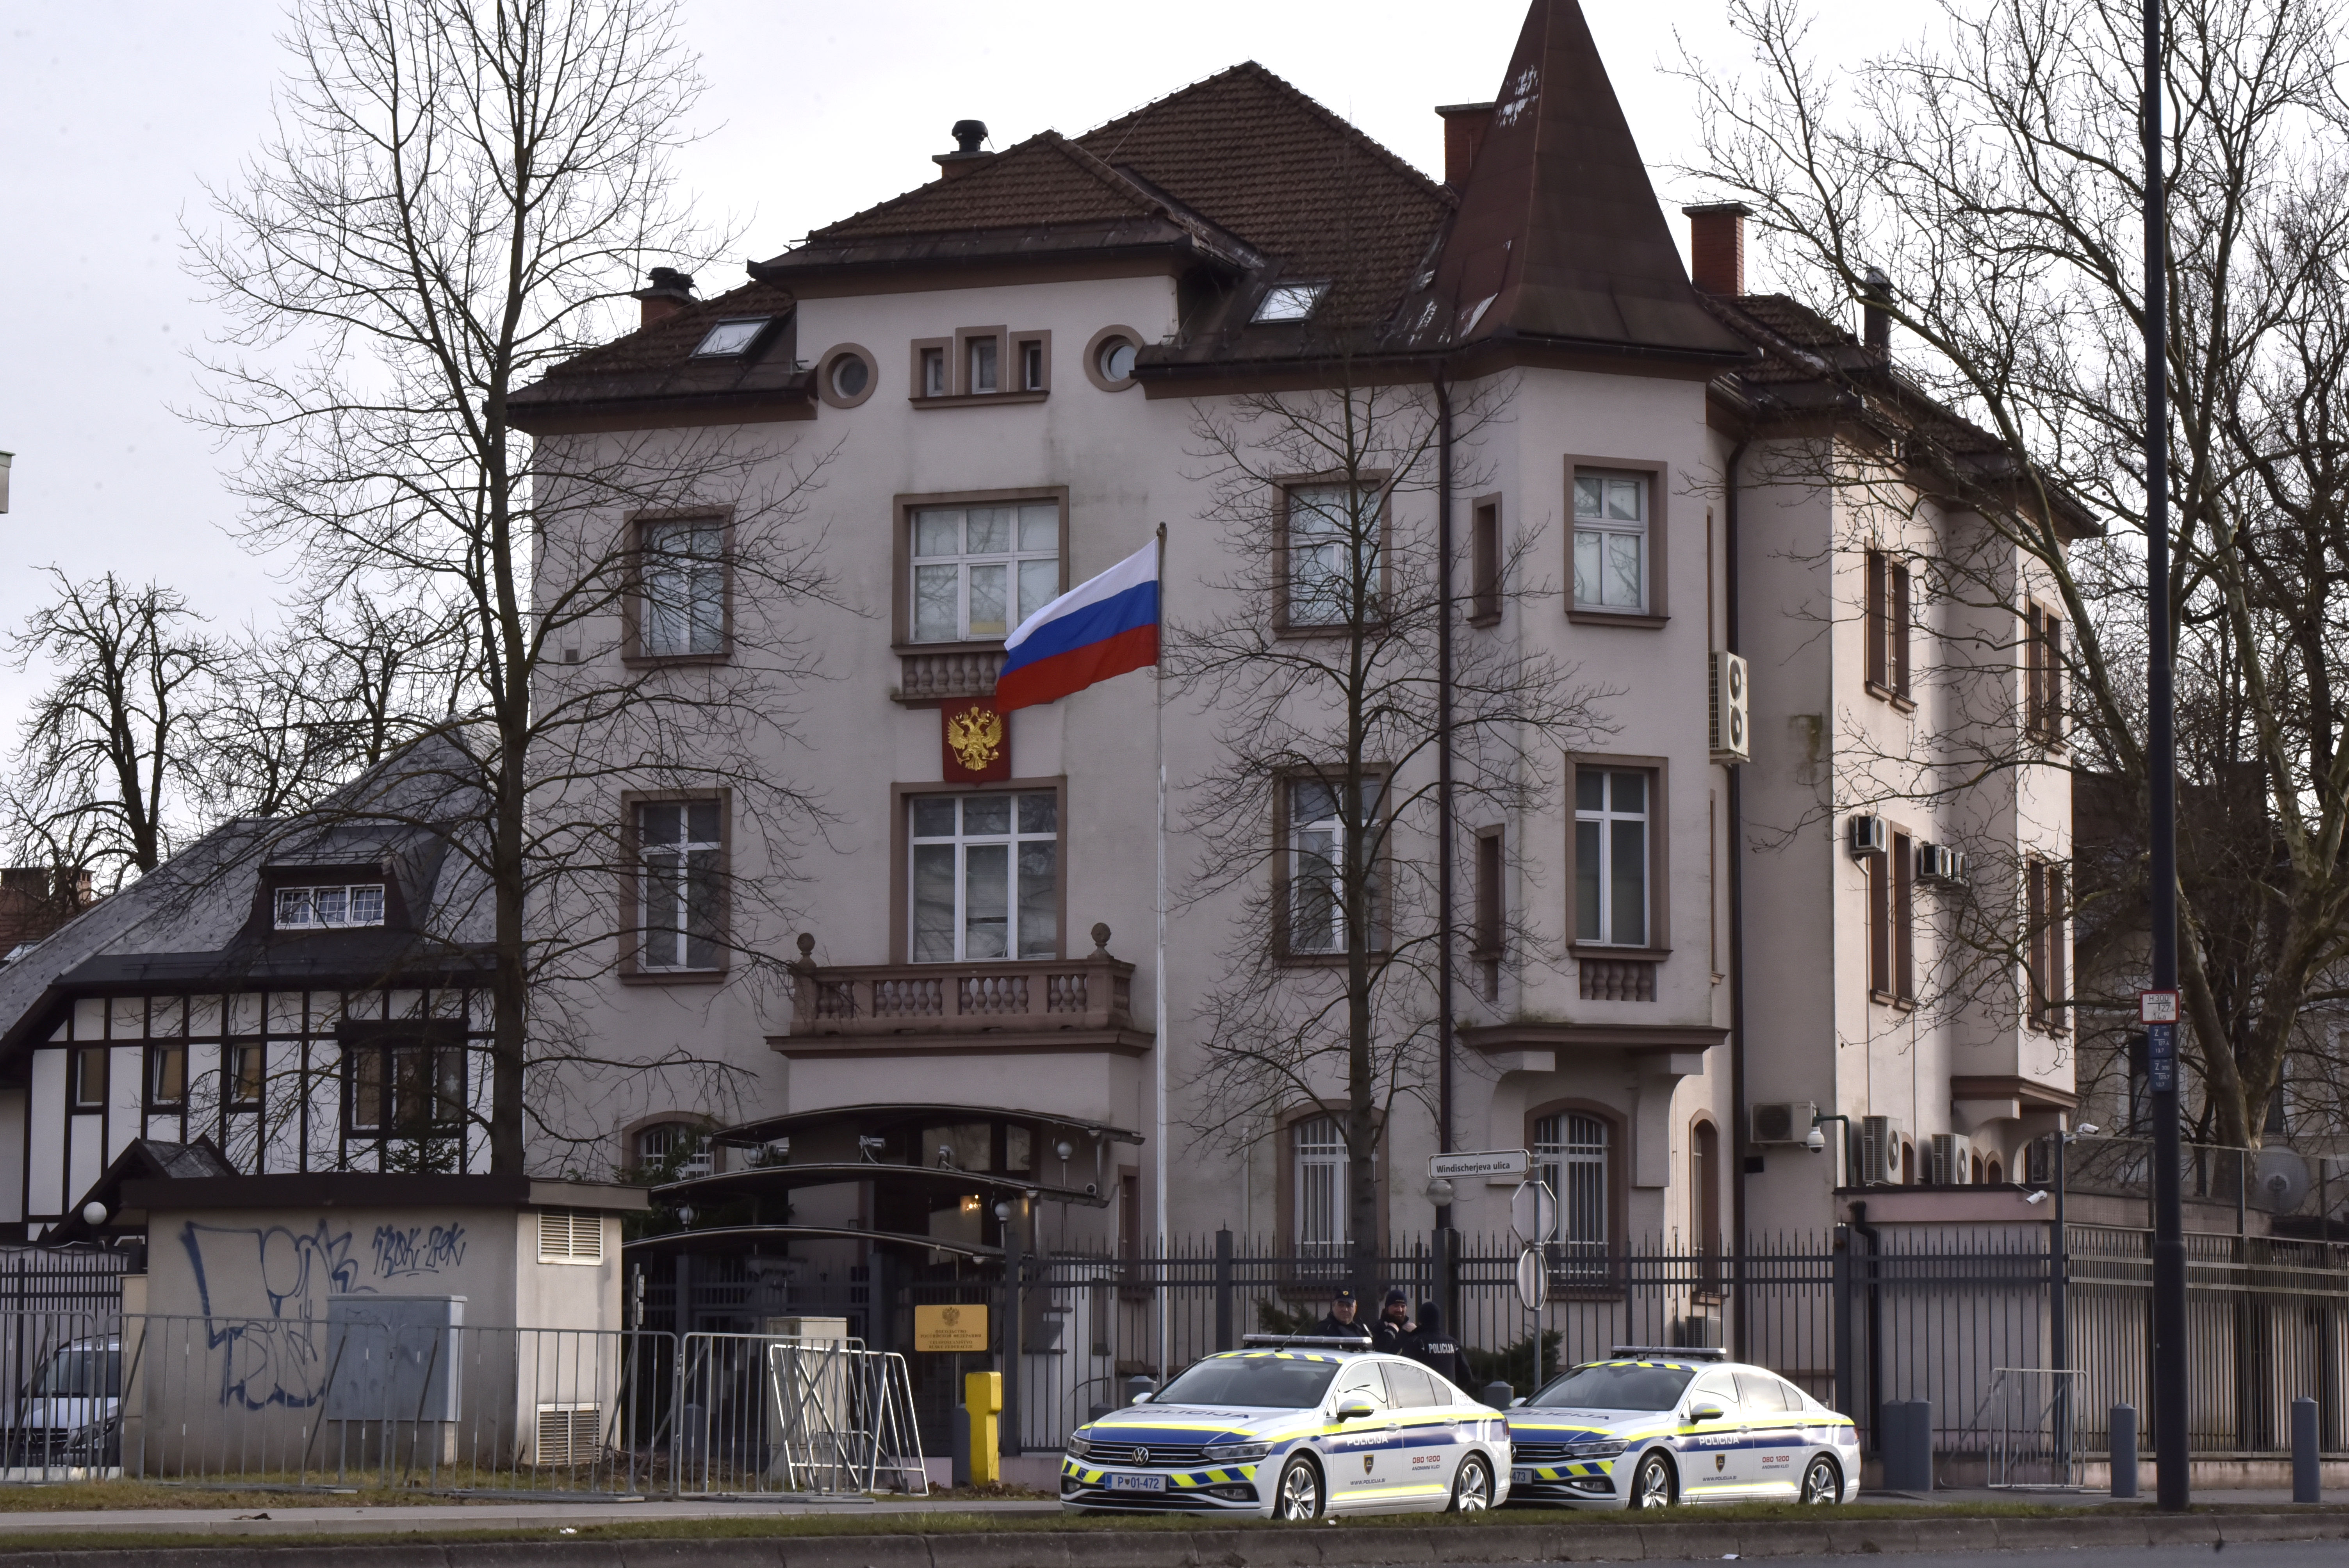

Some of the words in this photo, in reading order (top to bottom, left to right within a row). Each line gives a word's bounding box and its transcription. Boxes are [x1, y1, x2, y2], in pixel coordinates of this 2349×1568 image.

[1436, 1162, 1491, 1173] Windischerjeva
[1493, 1161, 1510, 1170] ulica
[1428, 1343, 1454, 1354] POLICIJA
[1121, 1410, 1249, 1419] POLICIJA
[1347, 1433, 1388, 1447] POLICIJA
[1698, 1435, 1740, 1446] POLICIJA
[1118, 1476, 1124, 1487] P
[1131, 1477, 1159, 1489] 01-472
